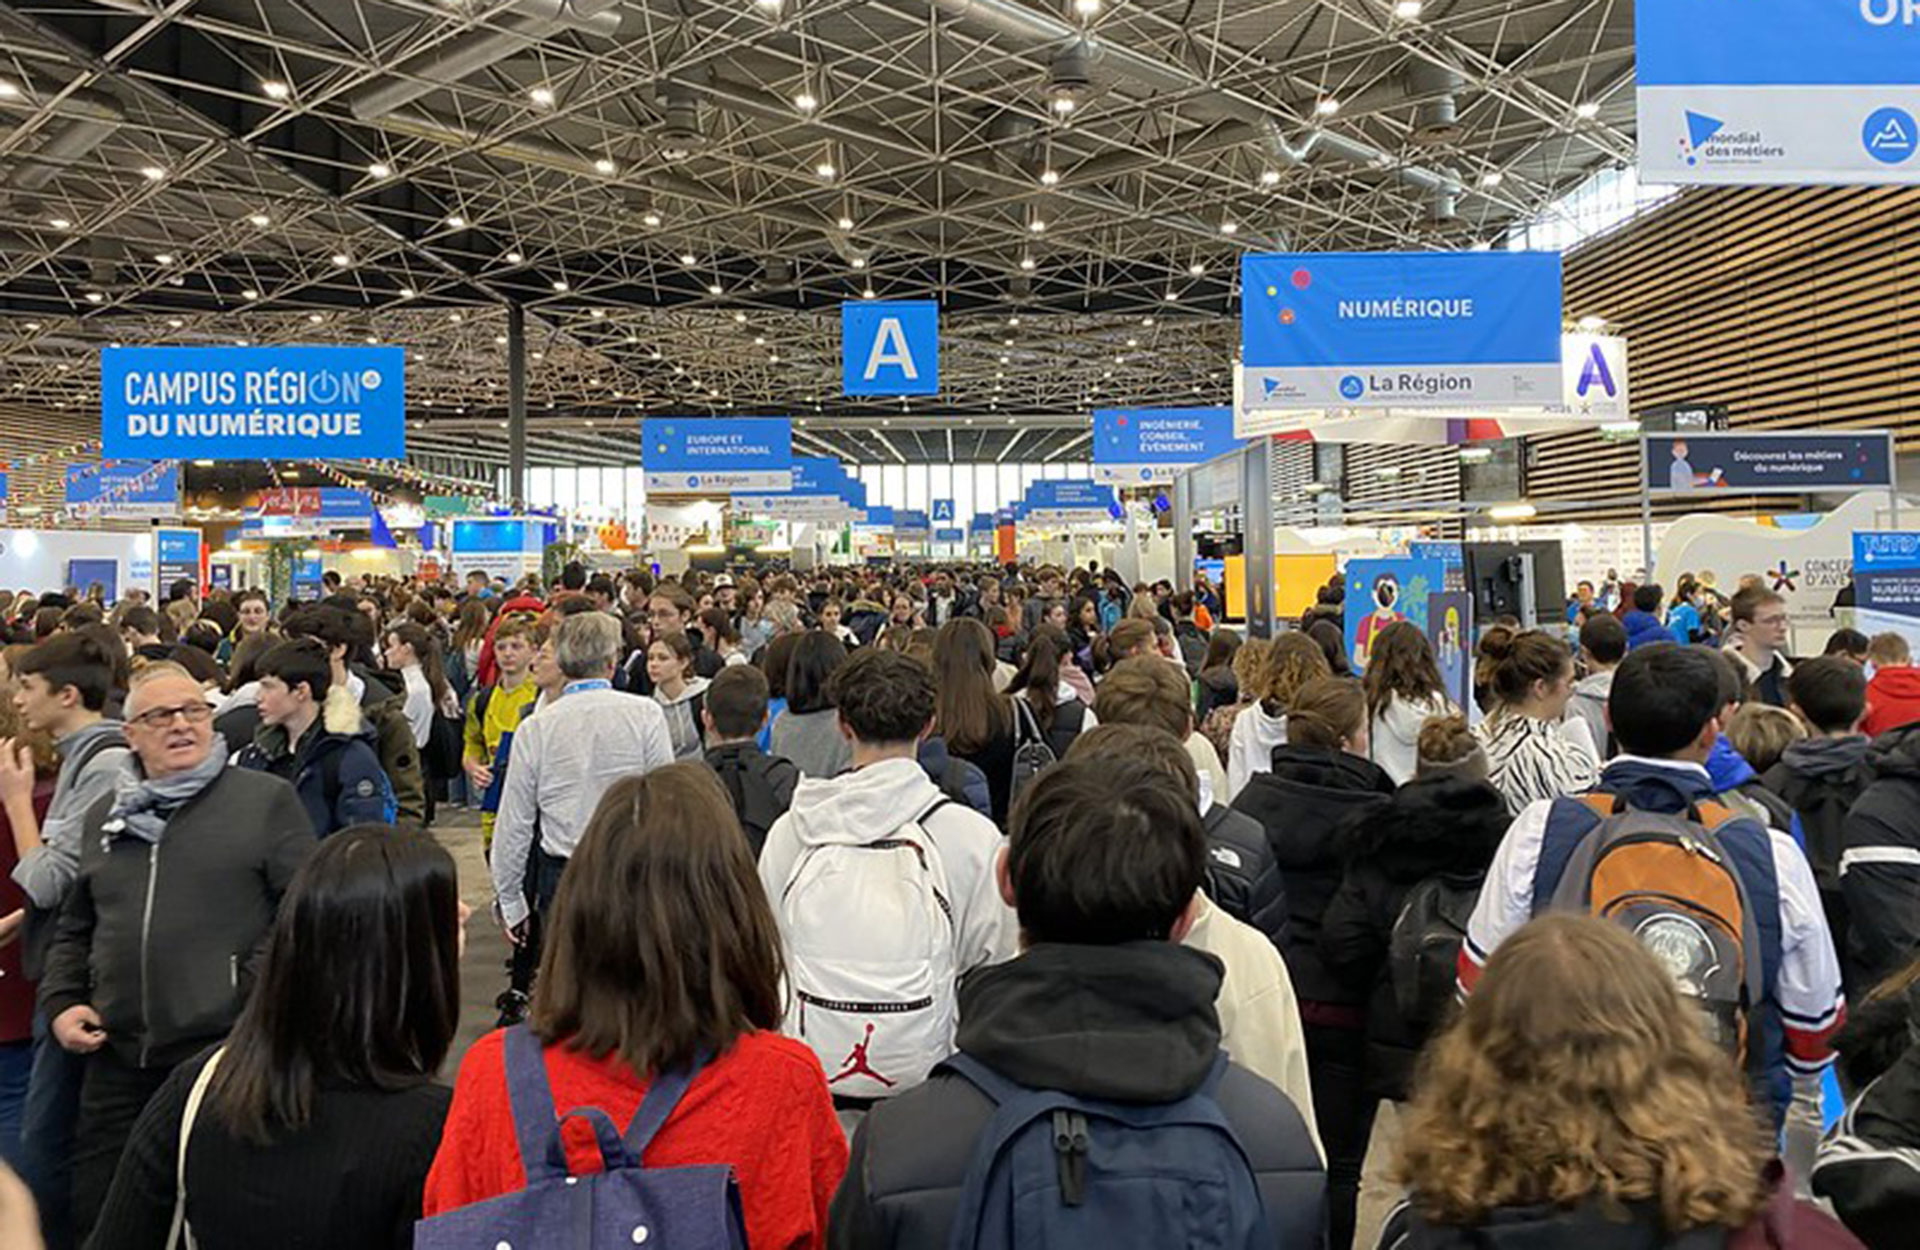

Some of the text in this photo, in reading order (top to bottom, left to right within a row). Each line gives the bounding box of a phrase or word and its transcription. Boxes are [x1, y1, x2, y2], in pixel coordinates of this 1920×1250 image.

[1705, 144, 1784, 156] des métiers
[1338, 297, 1474, 318] NUMÉRIQUE
[863, 318, 918, 380] A
[125, 371, 237, 405] CAMPUS
[1369, 373, 1472, 395] La Région
[128, 408, 362, 439] DU NUMÉRIQUE
[686, 434, 743, 444] EUROPE ET
[686, 445, 770, 455] INTERNATIONAL
[1733, 450, 1843, 462] Découvrez les métiers
[1753, 462, 1824, 474] du numérique
[935, 501, 950, 518] A
